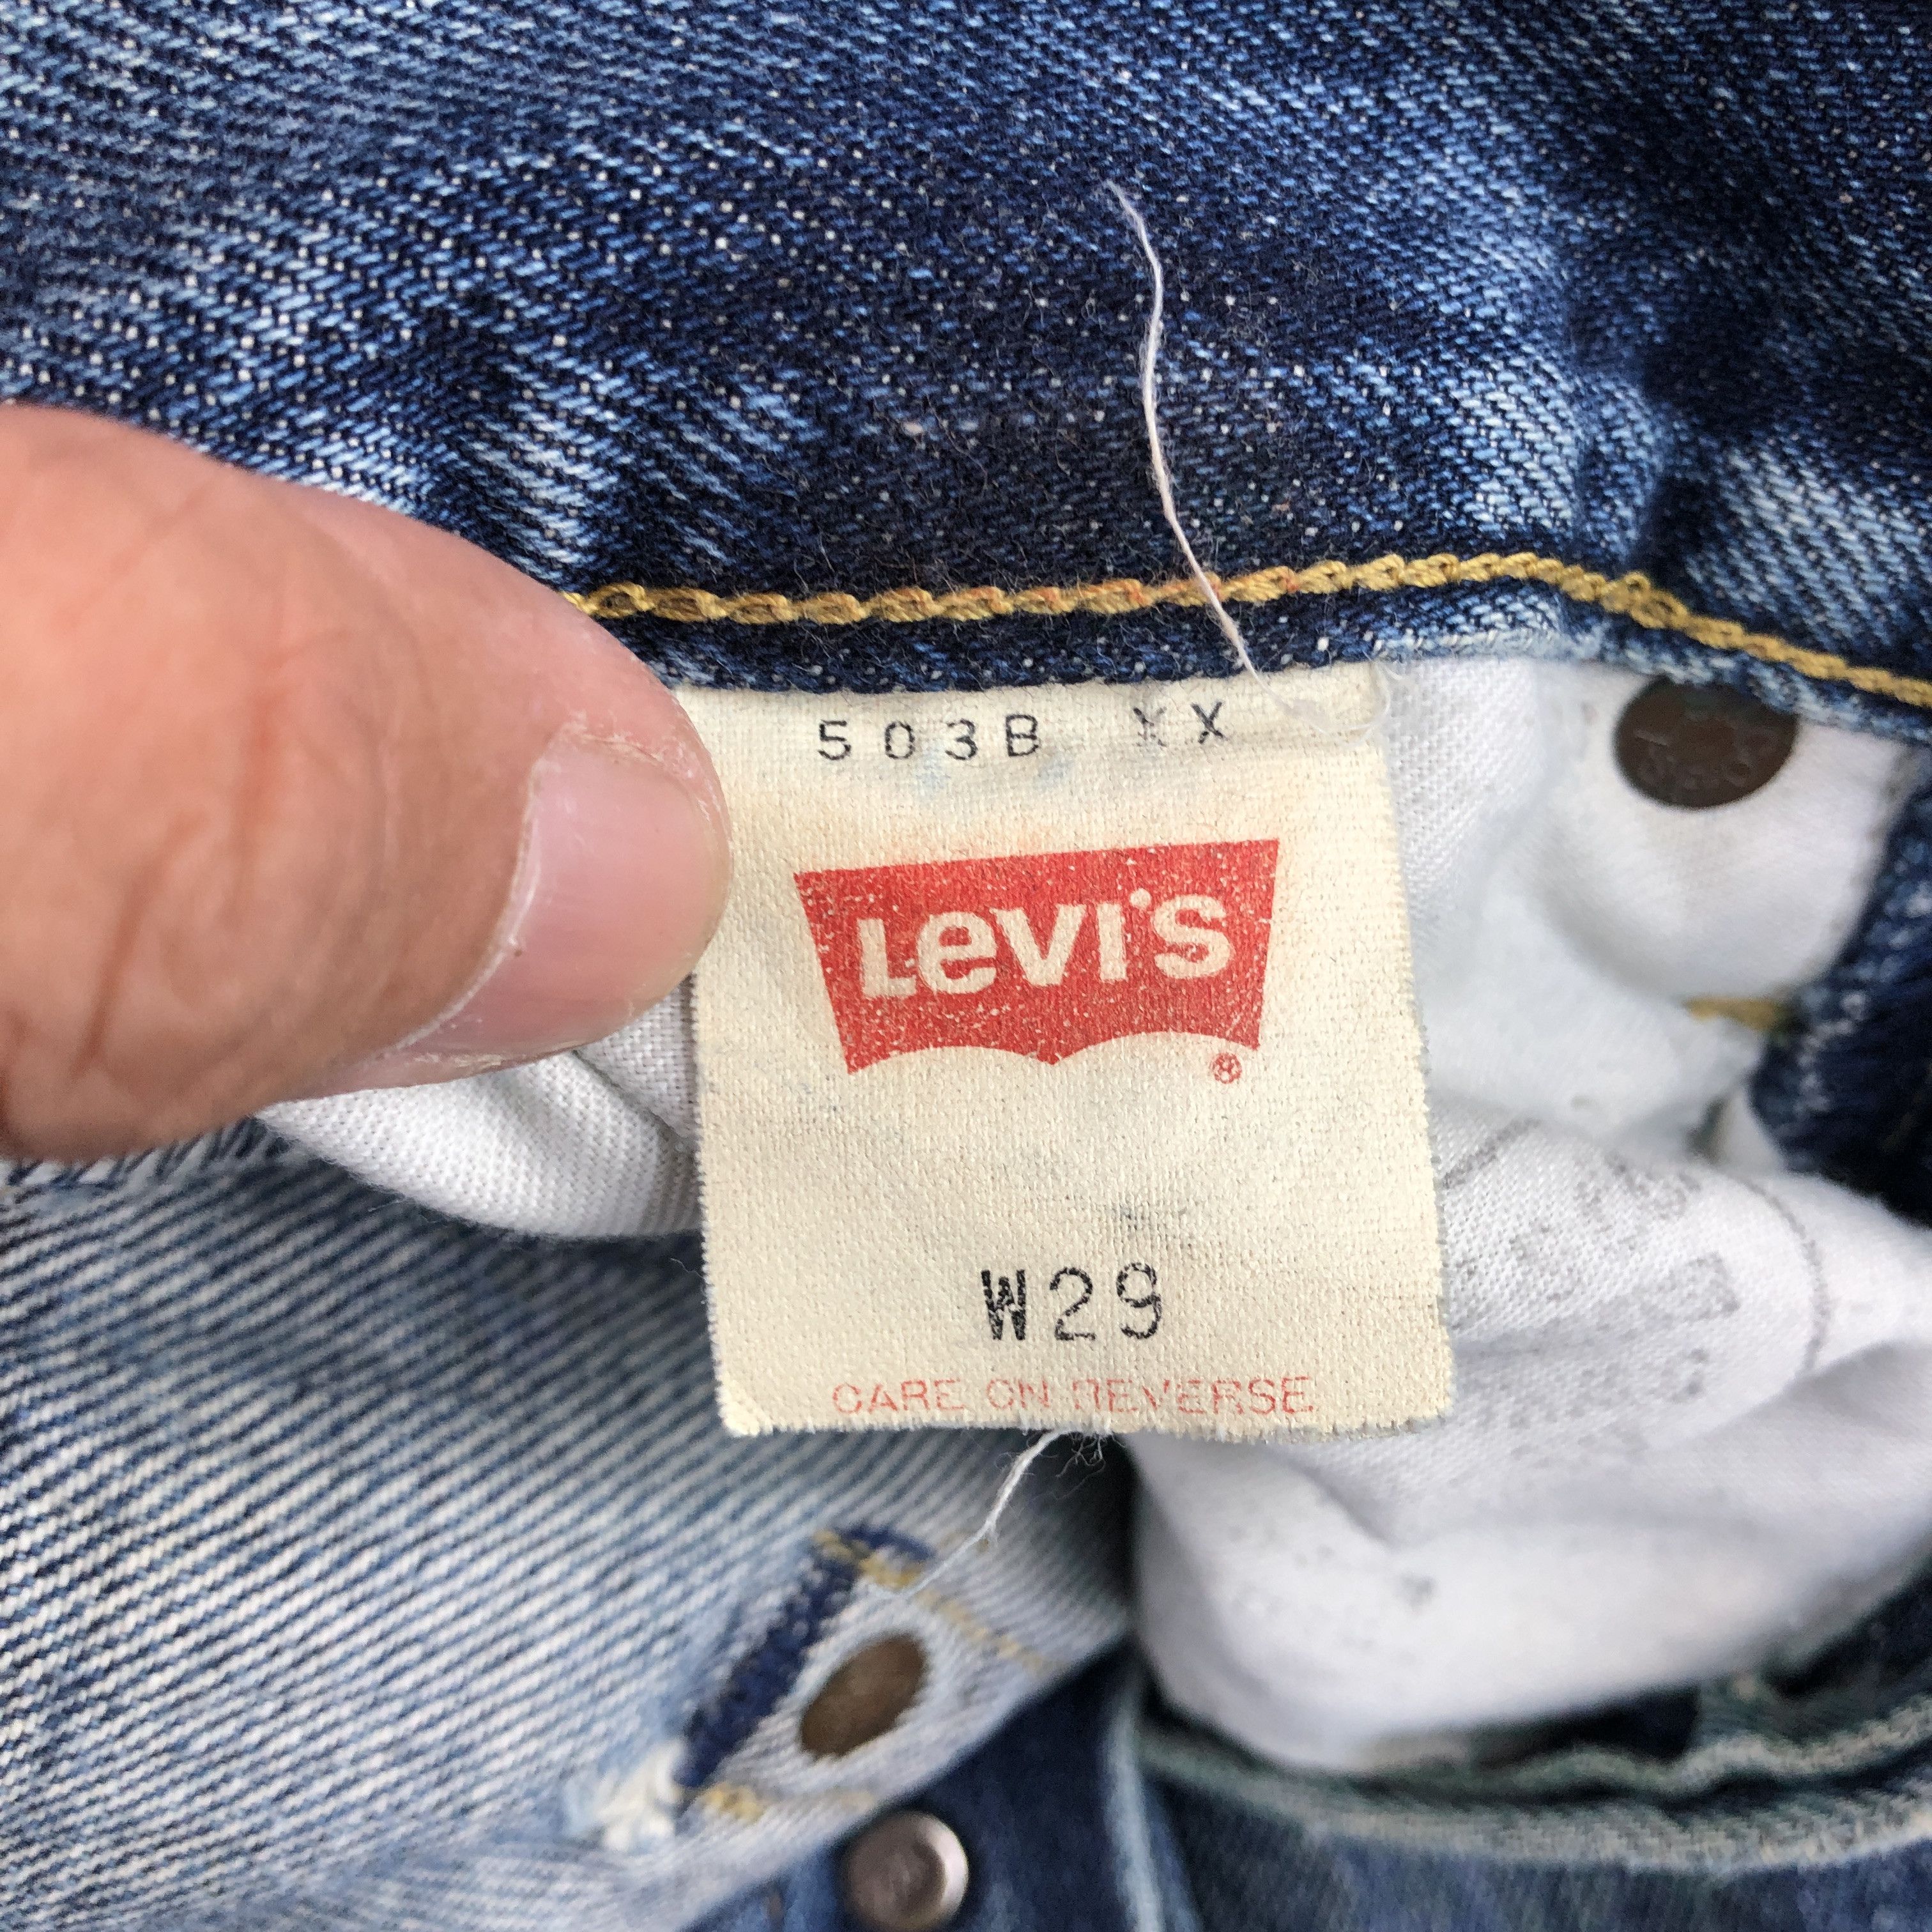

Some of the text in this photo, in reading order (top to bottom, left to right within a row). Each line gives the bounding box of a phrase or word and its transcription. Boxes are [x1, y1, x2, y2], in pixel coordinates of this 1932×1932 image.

[818, 714, 1041, 761] 503B
[981, 1262, 1162, 1340] W29
[832, 1376, 1314, 1414] CARE ON REVERSE
